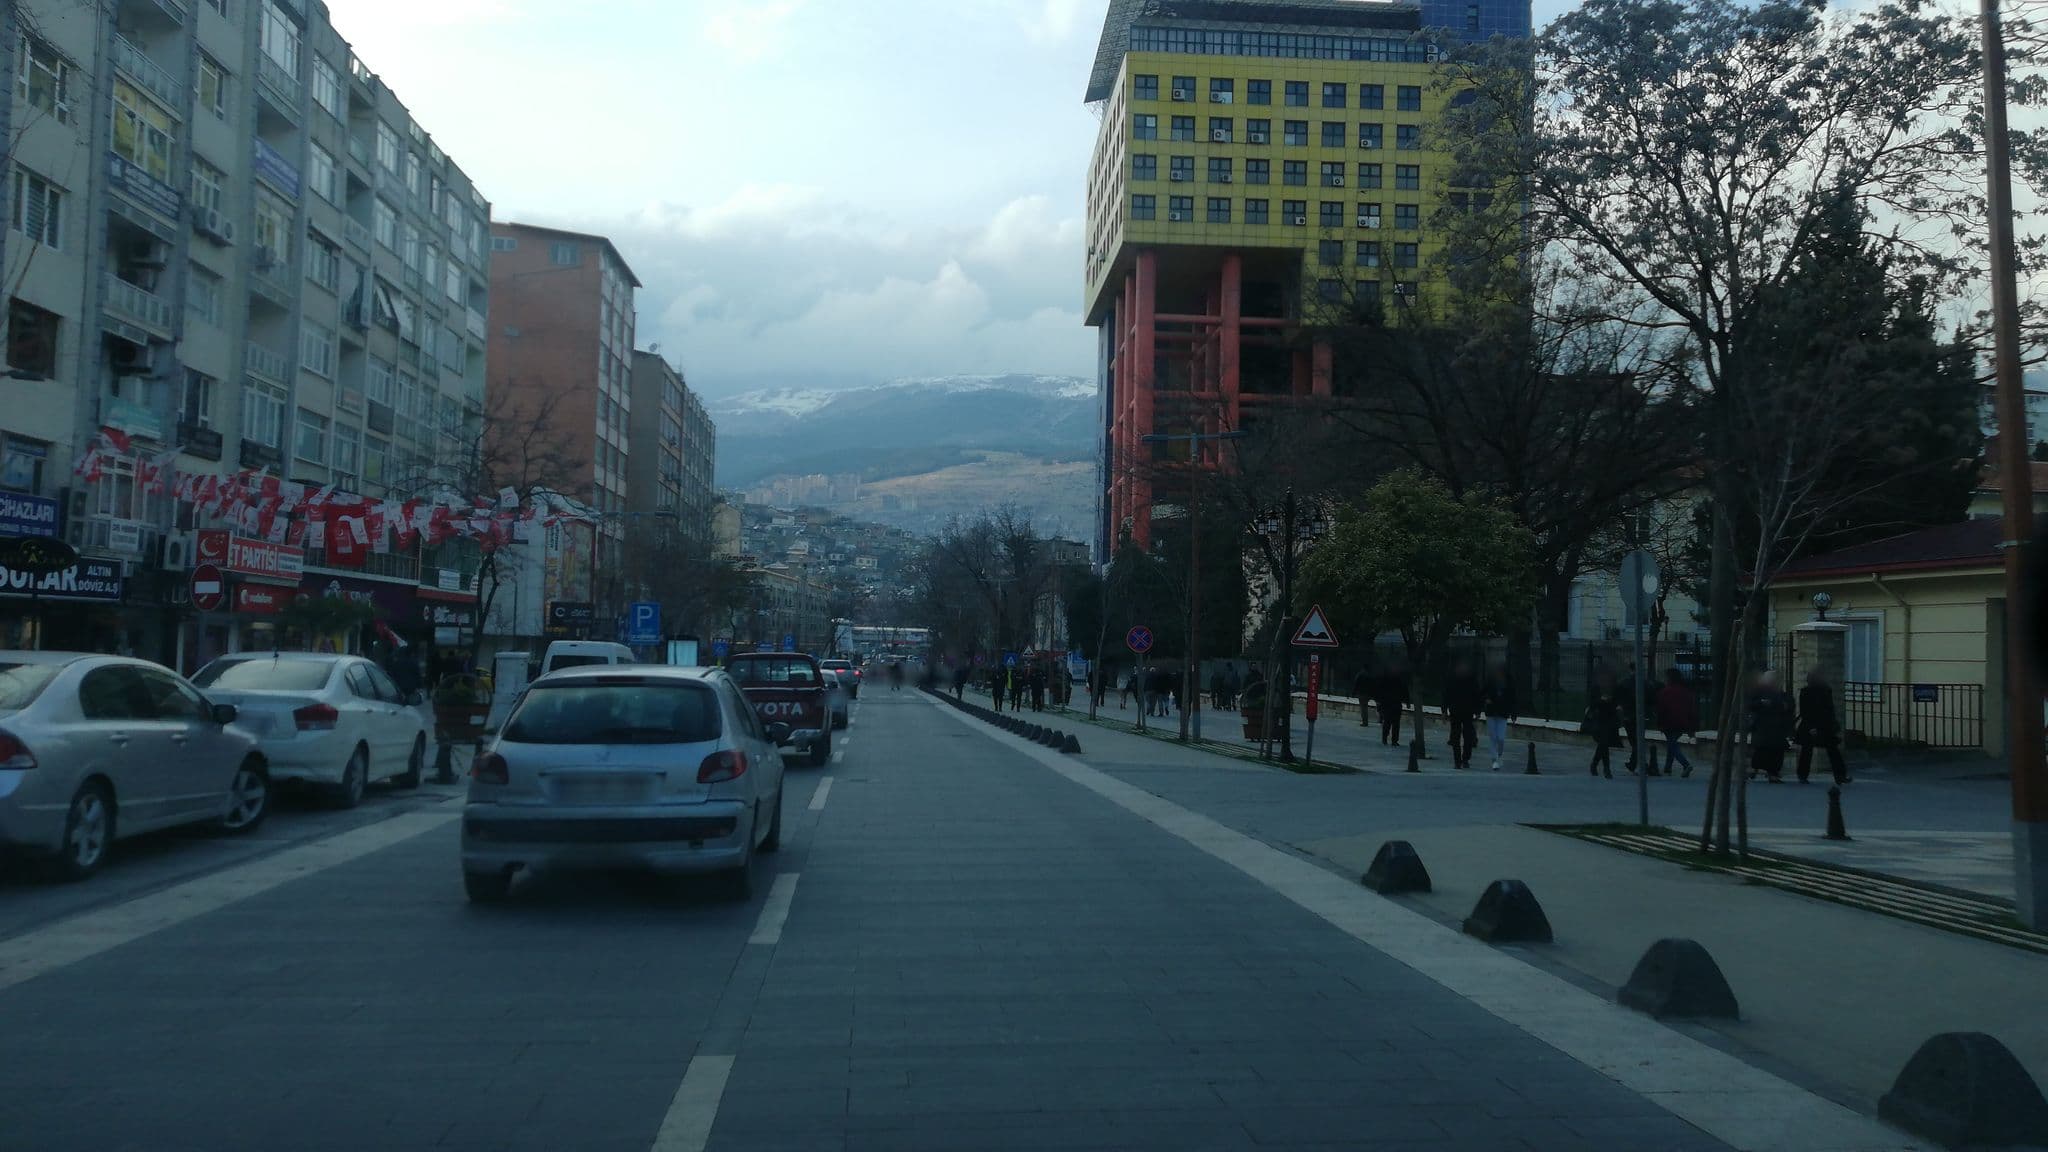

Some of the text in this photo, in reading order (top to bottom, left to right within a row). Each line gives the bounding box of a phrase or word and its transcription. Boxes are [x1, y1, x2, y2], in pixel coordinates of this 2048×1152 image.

[241, 545, 278, 572] PARTİSİ
[87, 565, 112, 577] ALTIN
[636, 605, 653, 628] P
